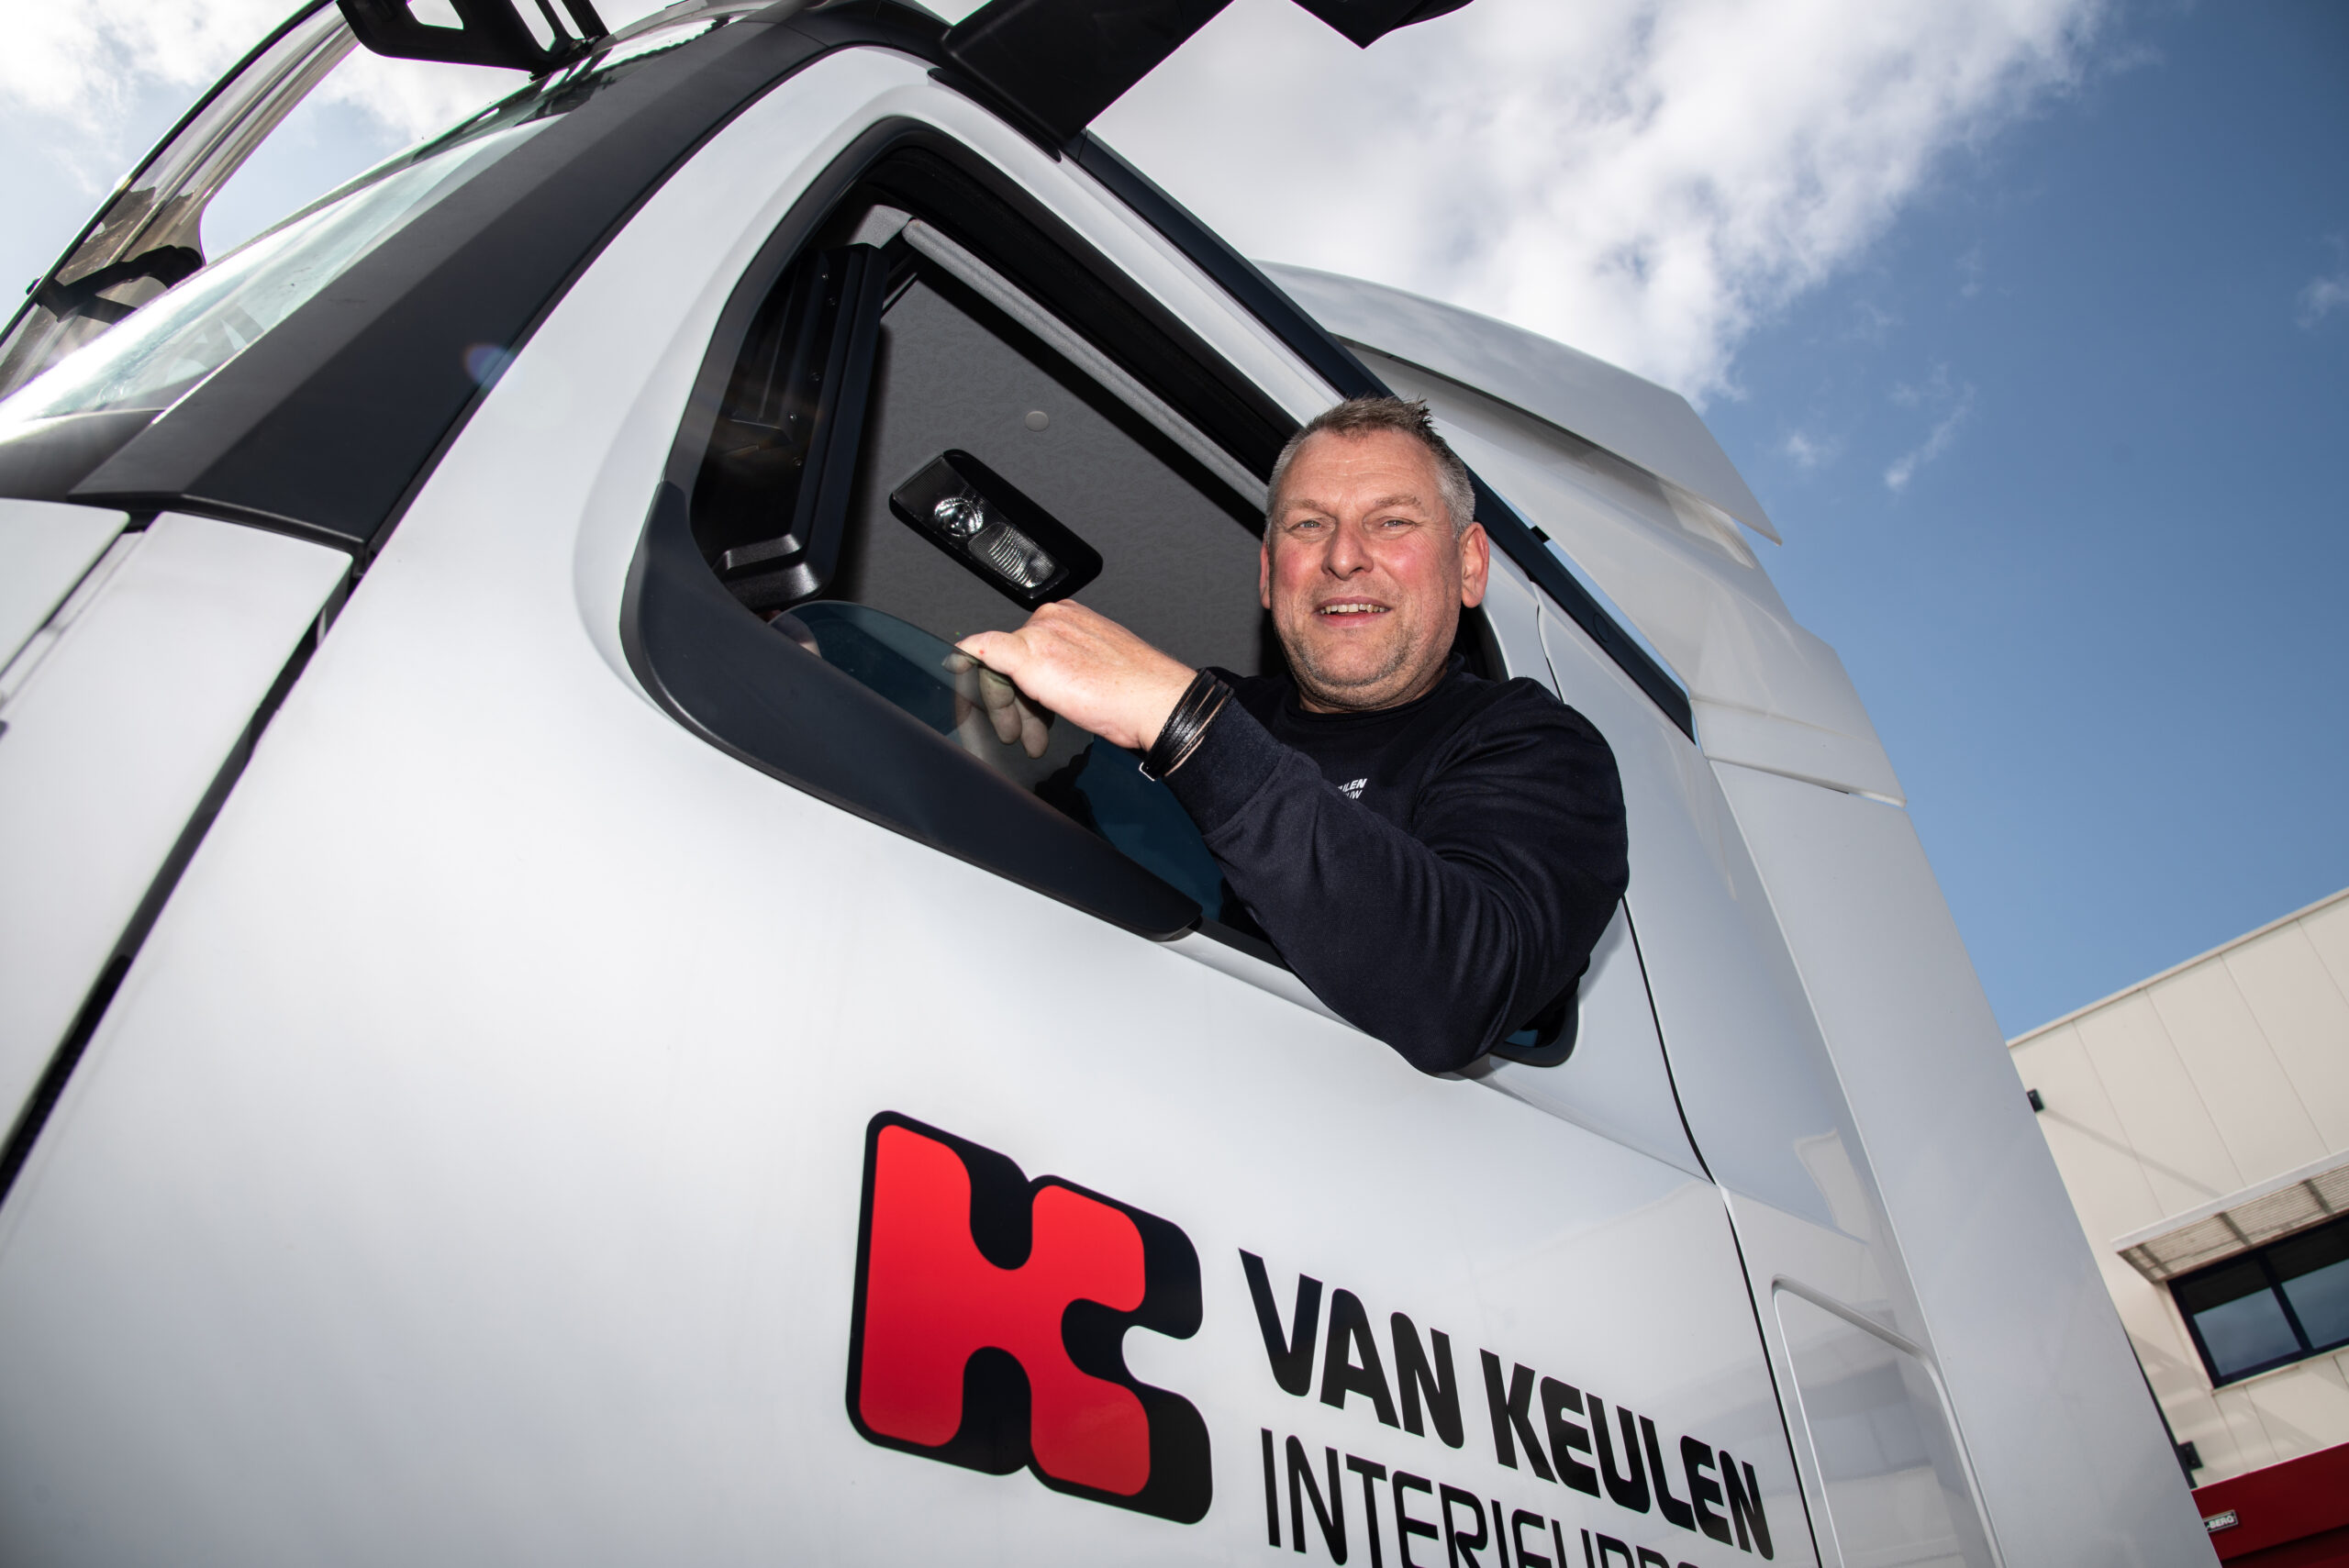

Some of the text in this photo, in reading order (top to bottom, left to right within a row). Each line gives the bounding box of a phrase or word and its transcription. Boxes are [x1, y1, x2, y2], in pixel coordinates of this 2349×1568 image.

[1238, 1248, 1775, 1562] VAN KEULEN
[1261, 1427, 1699, 1568] INTERIE
